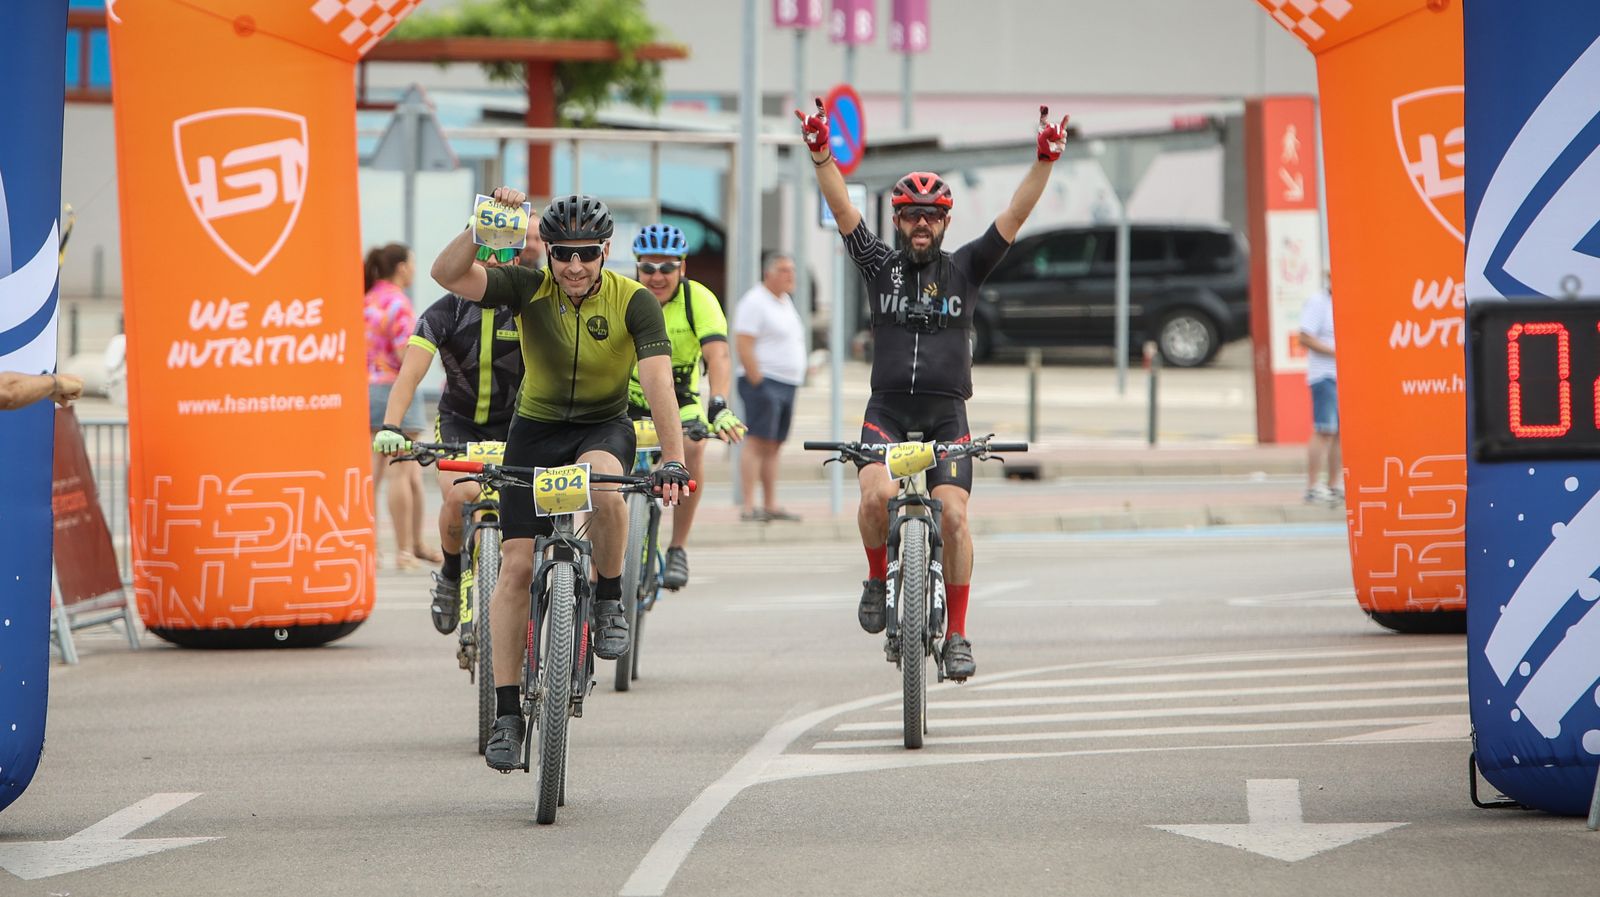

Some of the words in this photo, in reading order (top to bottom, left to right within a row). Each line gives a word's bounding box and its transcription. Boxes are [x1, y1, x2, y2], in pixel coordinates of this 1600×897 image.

[480, 209, 520, 231] 561
[189, 298, 249, 331] WE
[261, 298, 324, 328] ARE
[167, 329, 347, 370] NUTRITION!
[1402, 373, 1466, 395] www.h
[1508, 322, 1600, 438] 0
[177, 393, 343, 415] www.hsnstore.com
[539, 475, 584, 493] 304
